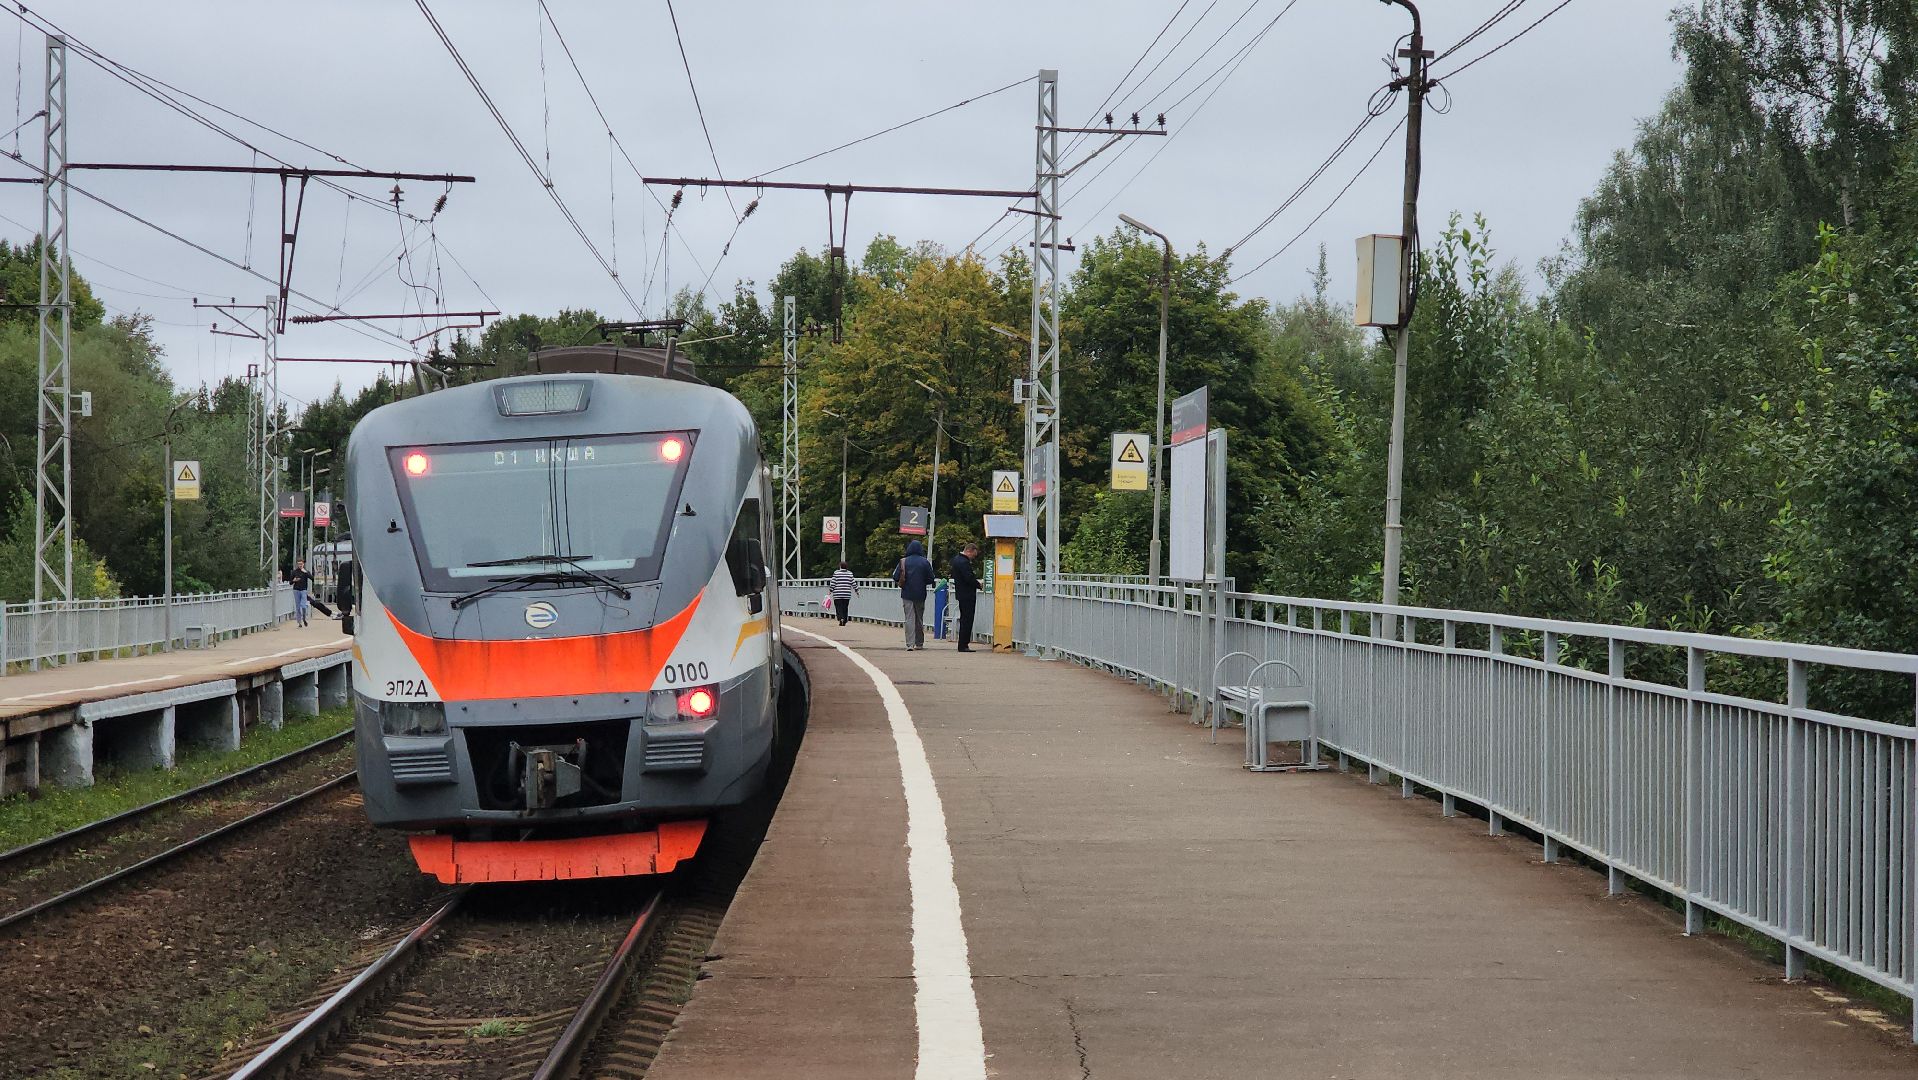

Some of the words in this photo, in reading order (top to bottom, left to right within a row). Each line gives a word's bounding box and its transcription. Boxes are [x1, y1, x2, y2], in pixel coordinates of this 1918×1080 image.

[535, 446, 595, 463] ИКША
[289, 495, 295, 508] 1
[909, 510, 919, 524] 2
[664, 661, 709, 684] 0100
[385, 679, 428, 698] ЭП2Д
